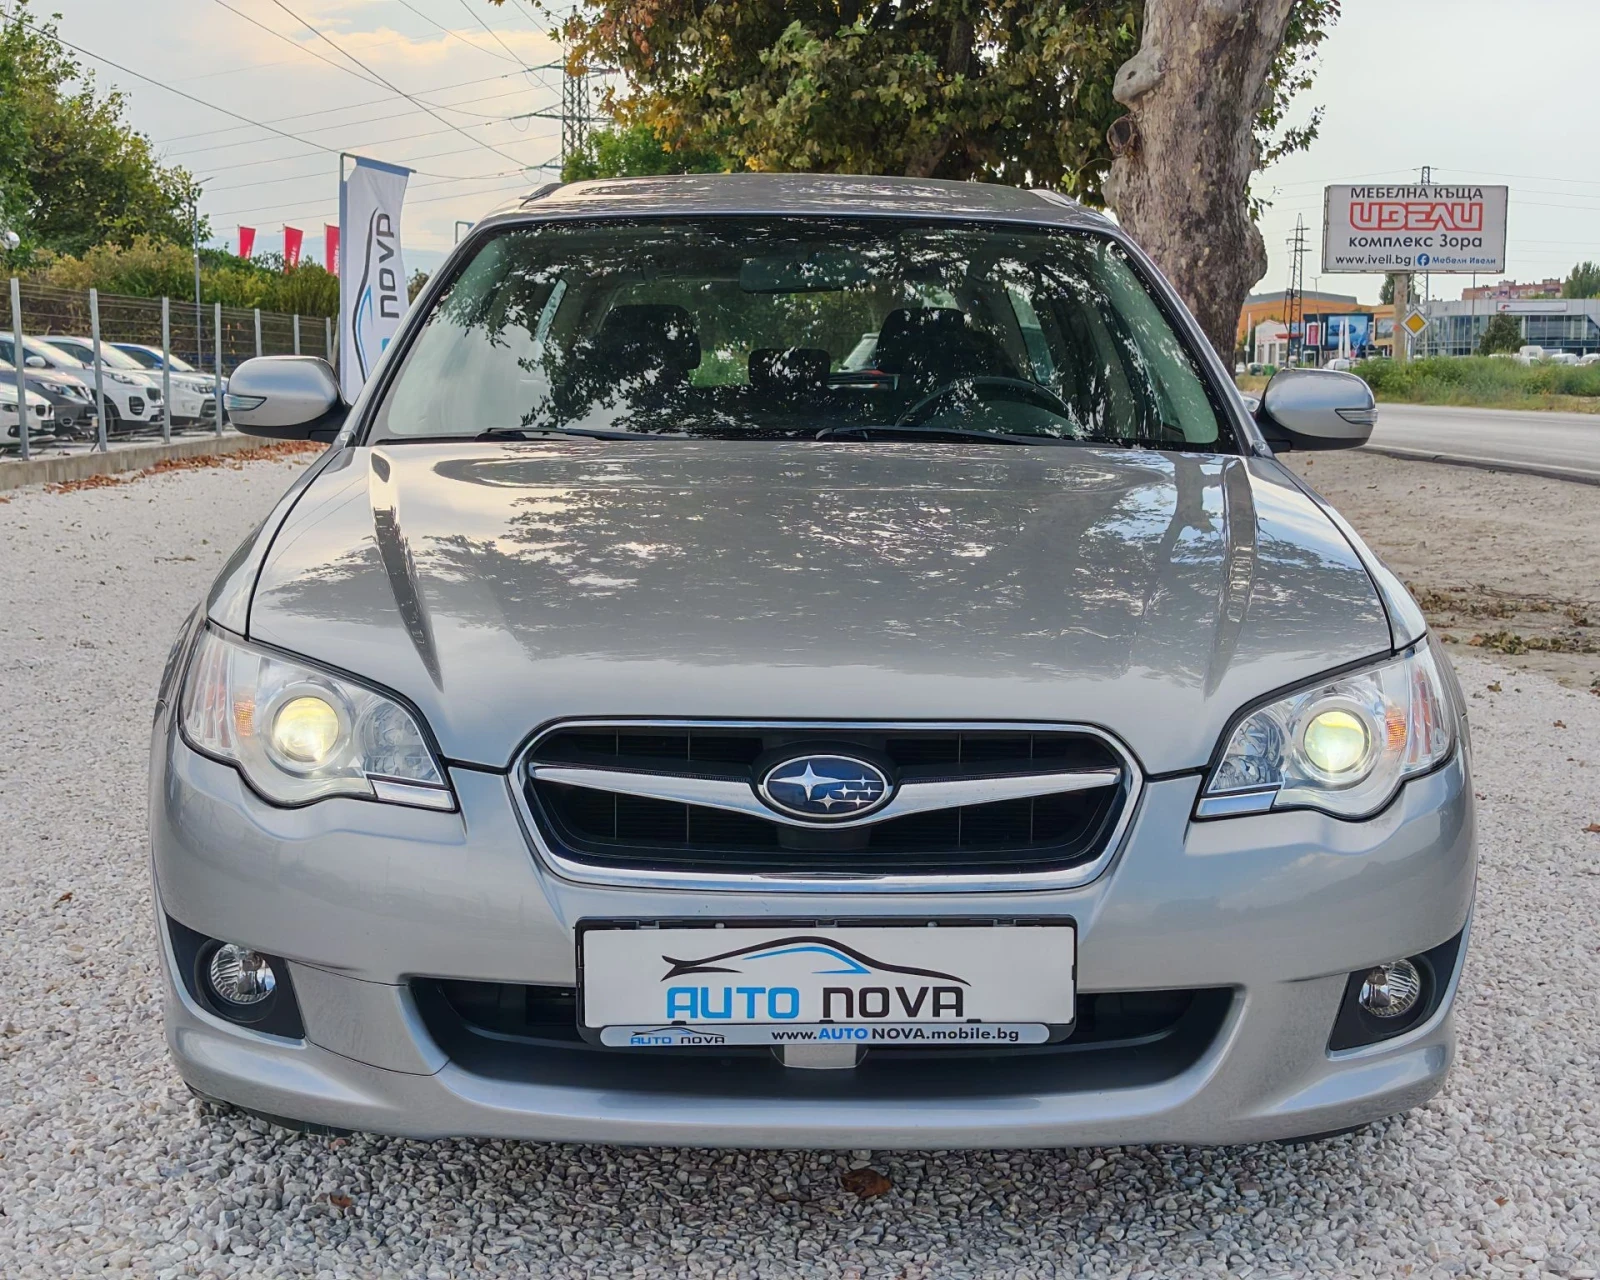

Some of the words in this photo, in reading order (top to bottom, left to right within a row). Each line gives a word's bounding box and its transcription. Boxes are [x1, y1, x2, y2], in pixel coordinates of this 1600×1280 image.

[1350, 187, 1429, 199] МЕБЕЛНА
[1434, 187, 1483, 201] КЪЩА
[1349, 202, 1483, 231] ИВЕЛИ
[1349, 236, 1433, 248] комплекс
[1439, 233, 1482, 251] Зора
[667, 986, 800, 1019] AUTO
[822, 986, 964, 1019] NOVA
[630, 1036, 672, 1045] AUTO
[680, 1036, 725, 1044] NOVA
